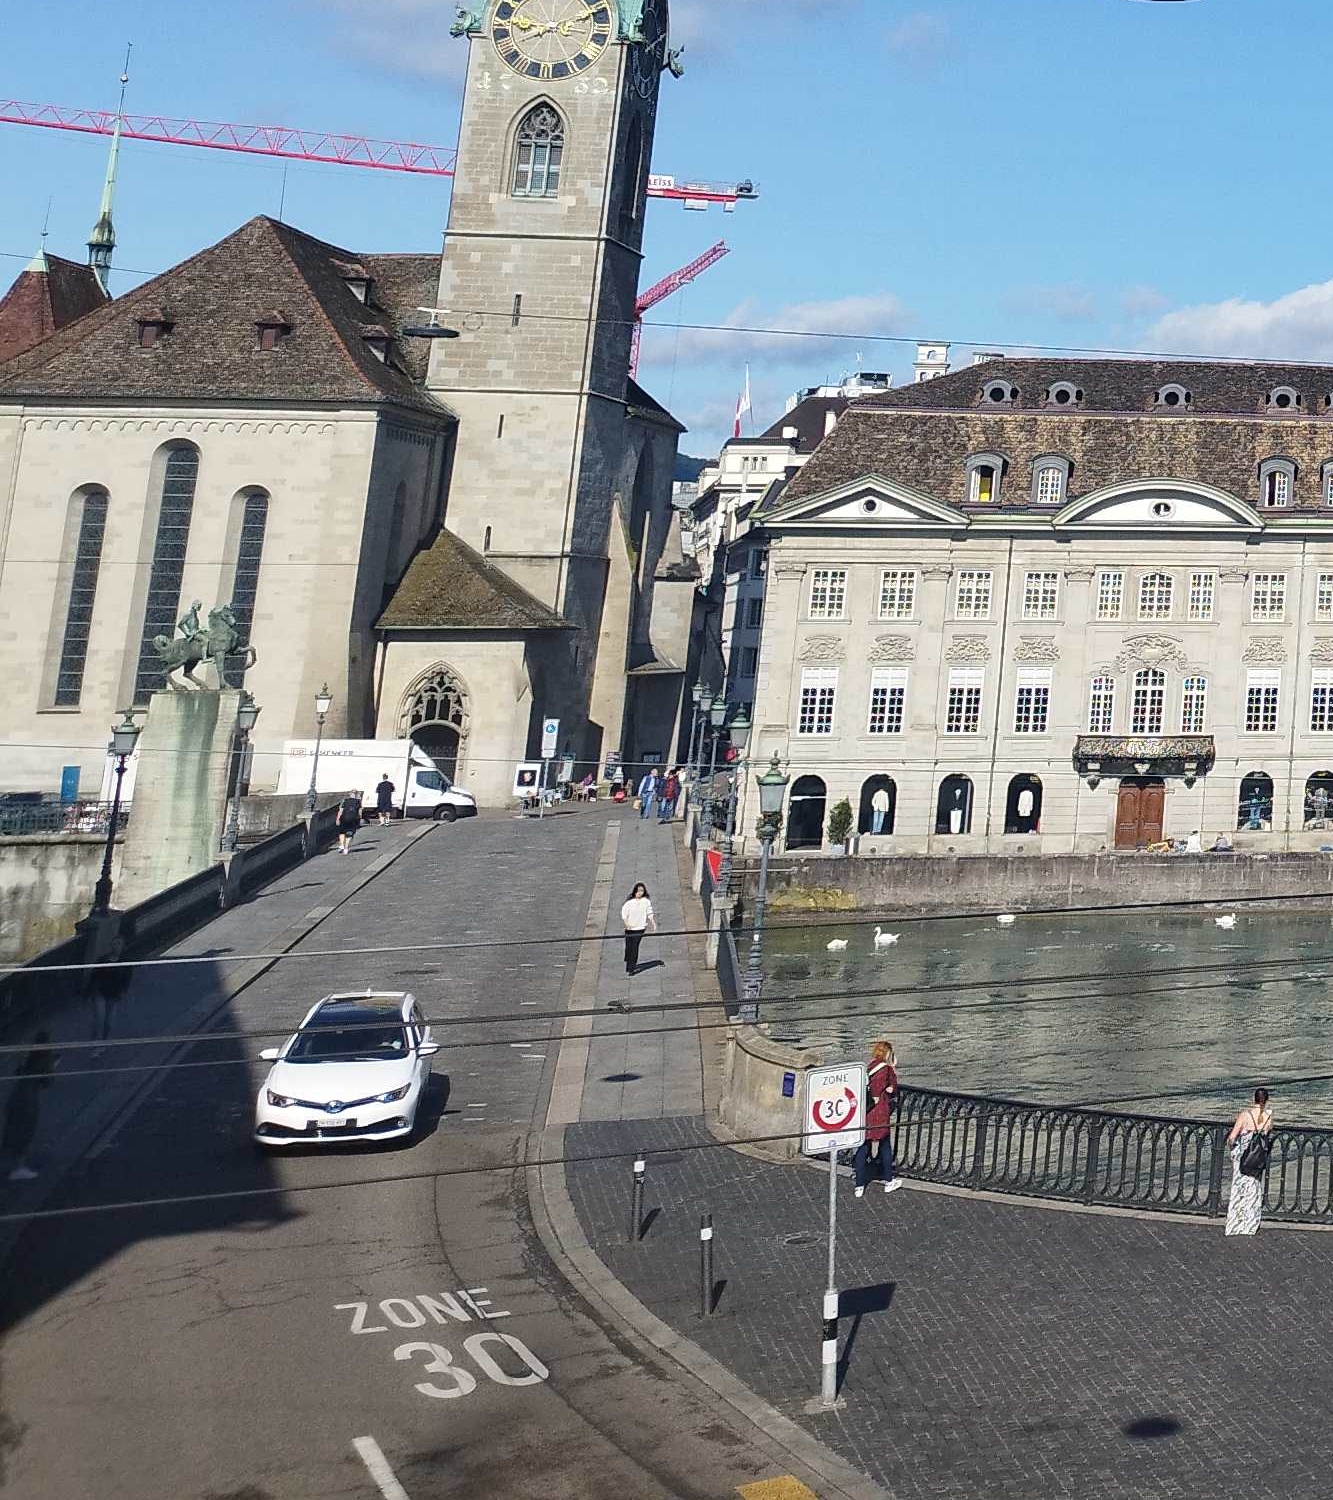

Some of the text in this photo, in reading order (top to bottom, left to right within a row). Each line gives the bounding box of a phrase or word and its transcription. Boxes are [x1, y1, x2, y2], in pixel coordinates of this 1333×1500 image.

[823, 1073, 849, 1086] ZONE
[333, 1287, 511, 1334] ZONE
[393, 1332, 549, 1399] 30
